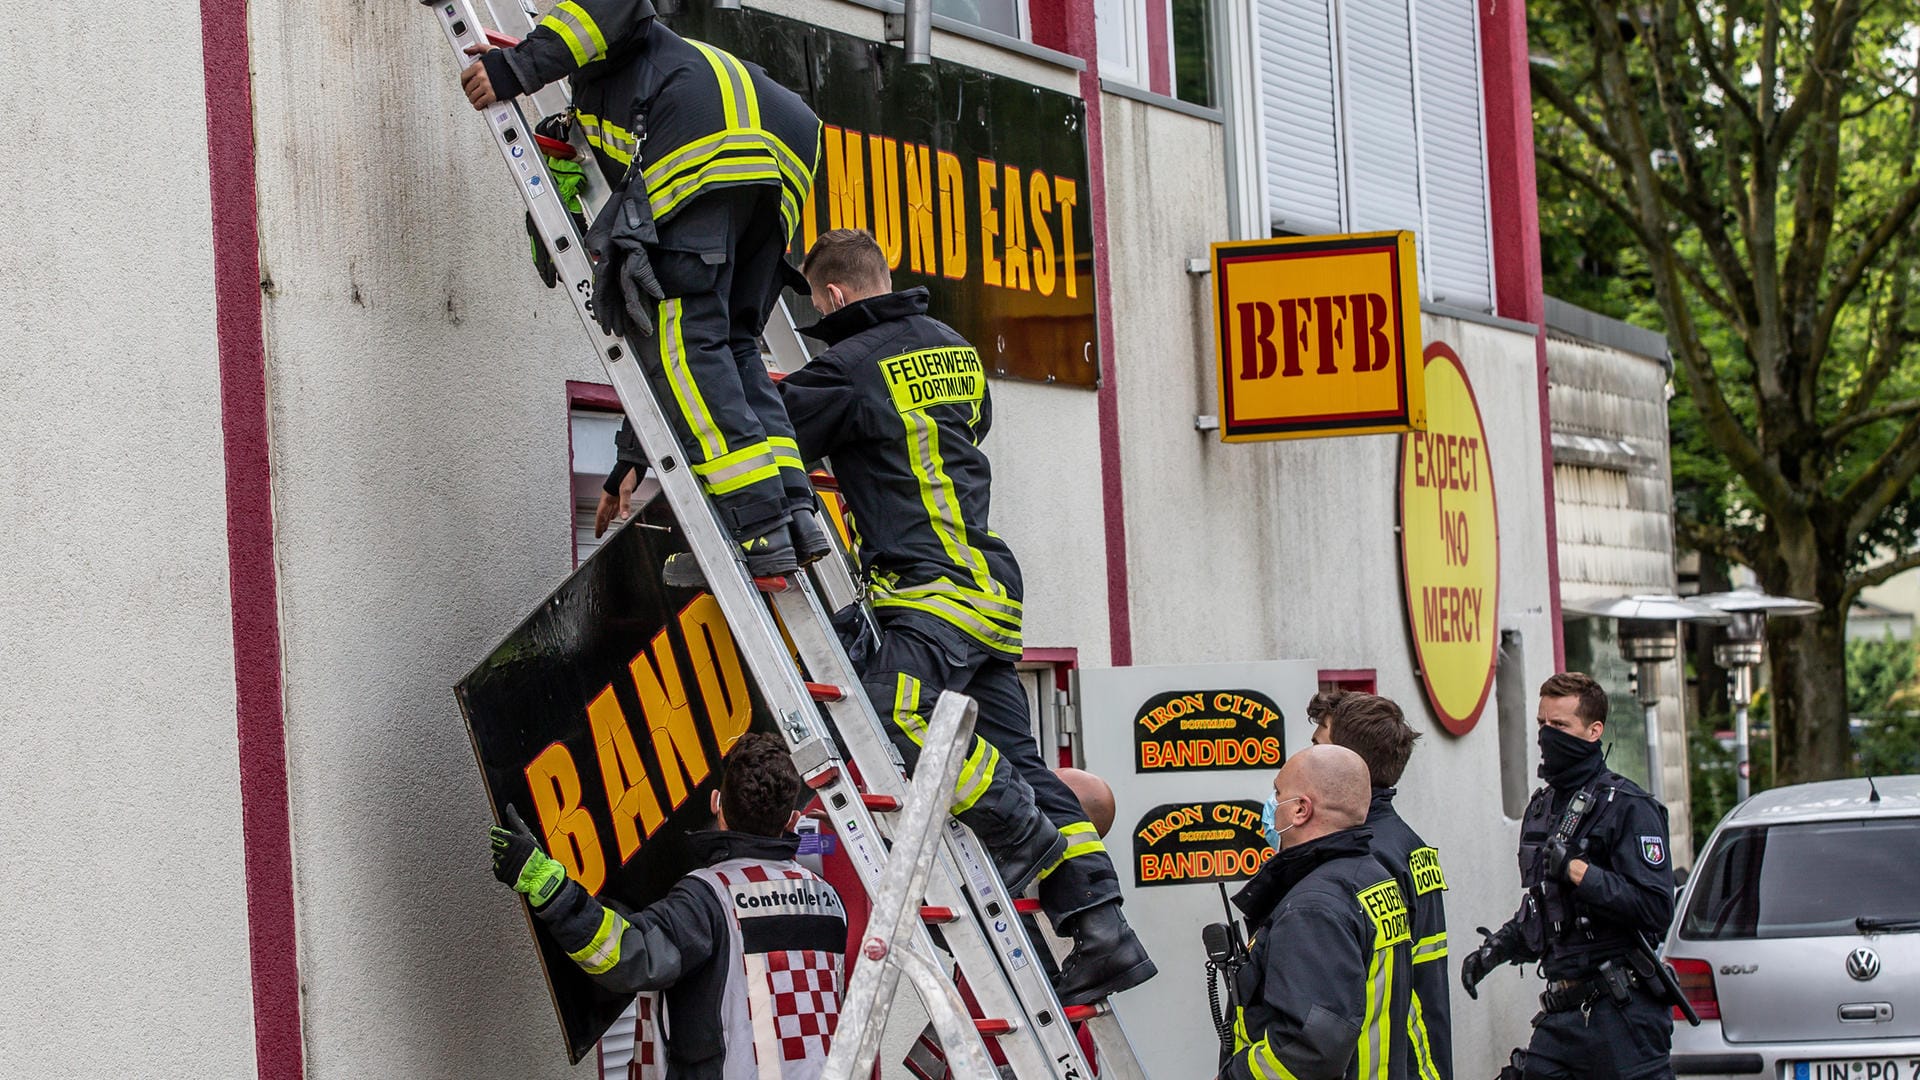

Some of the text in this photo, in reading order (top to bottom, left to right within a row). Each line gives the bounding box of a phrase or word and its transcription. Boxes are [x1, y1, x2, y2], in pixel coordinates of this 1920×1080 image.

[977, 157, 1078, 299] EAST
[1236, 292, 1390, 380] BFFB
[886, 350, 981, 385] FEUERWEHR
[908, 376, 976, 404] DORTMUND
[1414, 431, 1478, 540] EXPECT
[1445, 510, 1469, 567] NO
[1422, 585, 1483, 642] MERCY
[1139, 692, 1279, 733] IRON CITY
[1141, 736, 1280, 768] BANDIDOS
[1138, 803, 1266, 846] IRON CIT
[735, 888, 821, 909] Controller
